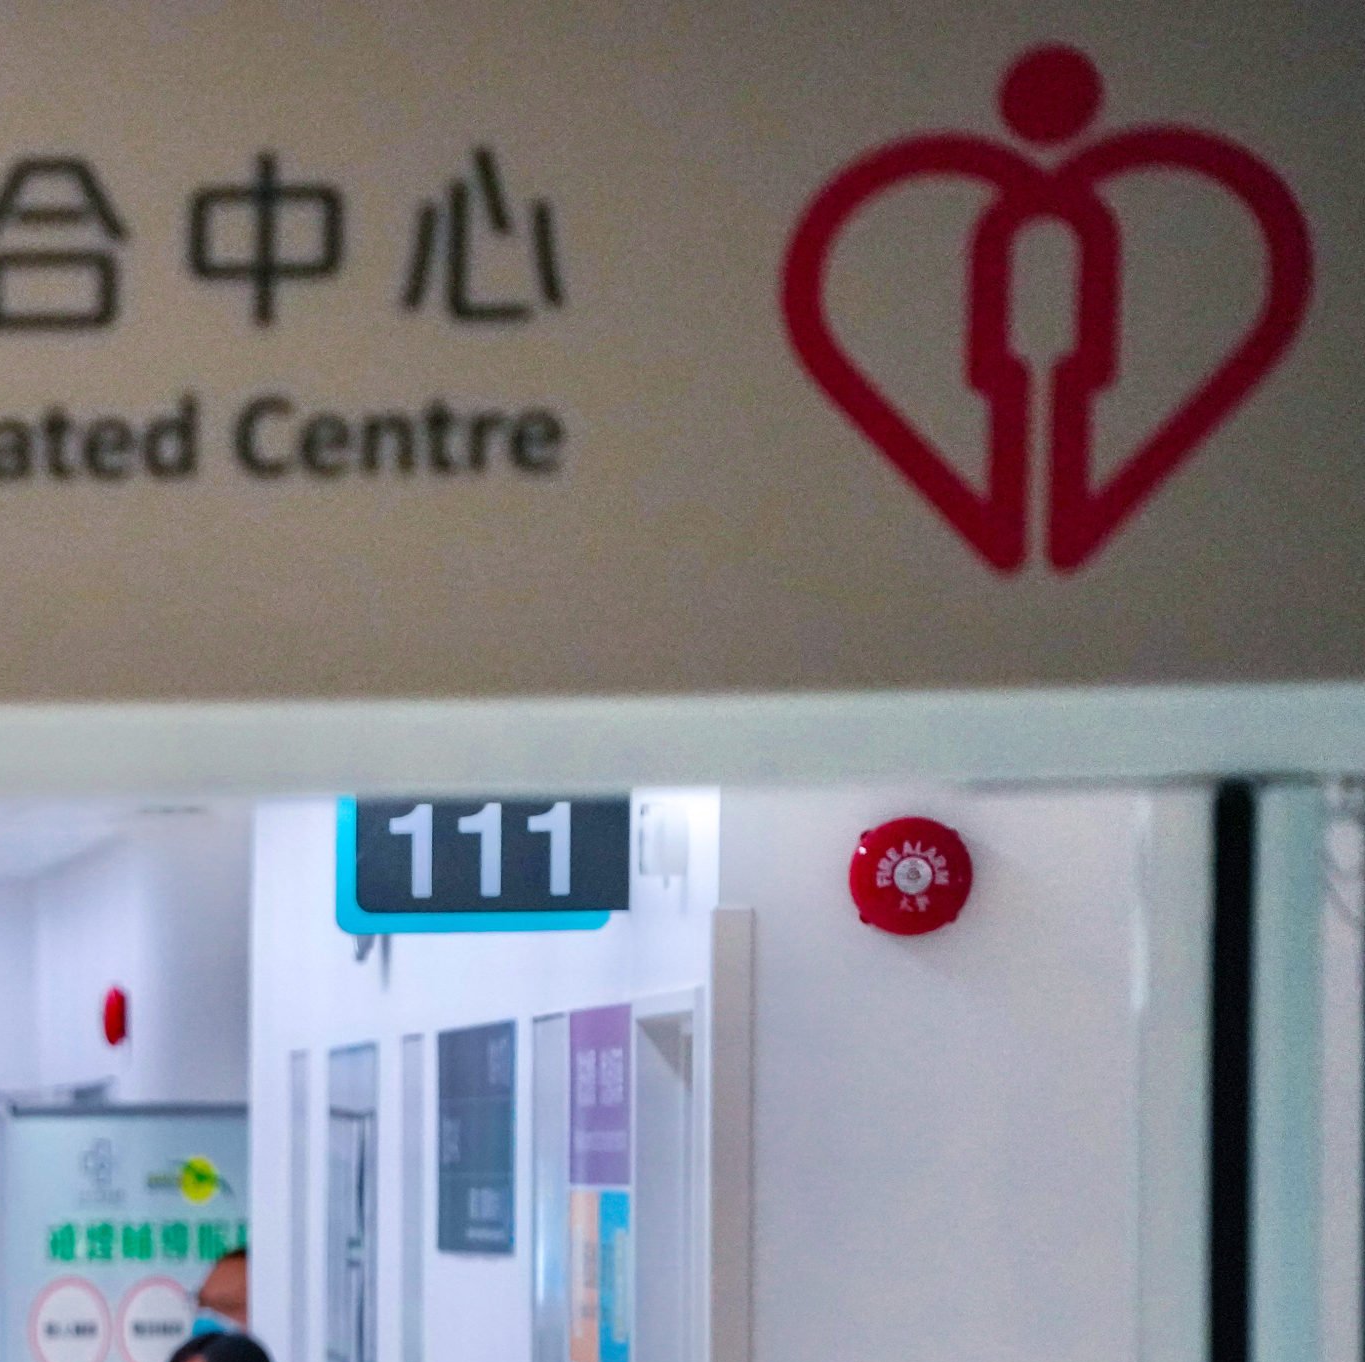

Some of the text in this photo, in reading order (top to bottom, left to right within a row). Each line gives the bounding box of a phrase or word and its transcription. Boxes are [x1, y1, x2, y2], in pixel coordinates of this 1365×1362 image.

[232, 395, 568, 481] Centre
[388, 801, 571, 899] 111
[875, 840, 950, 889] FIRE ALARM
